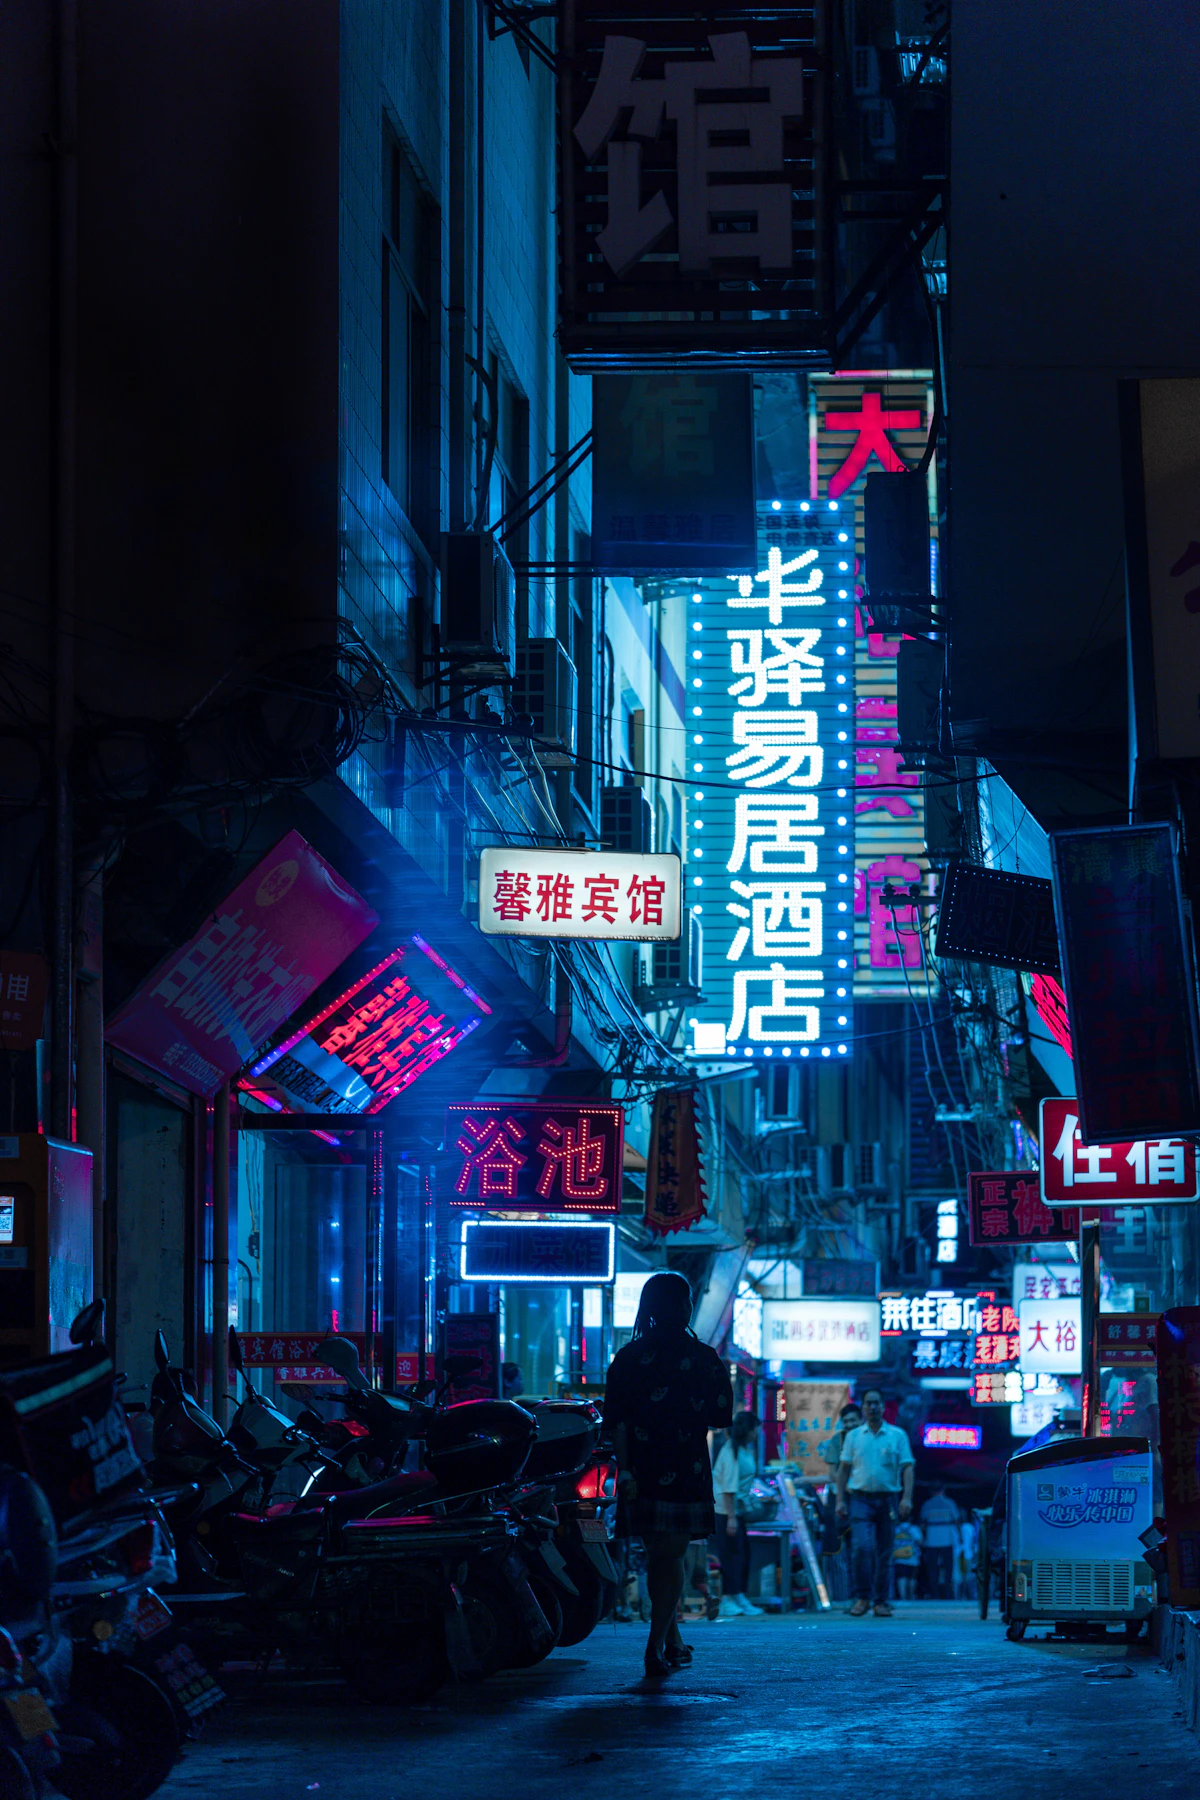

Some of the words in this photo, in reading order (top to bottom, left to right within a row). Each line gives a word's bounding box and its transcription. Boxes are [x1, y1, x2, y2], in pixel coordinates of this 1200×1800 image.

[573, 30, 803, 279] 馆
[725, 546, 827, 1042] 华驿易居酒店
[493, 869, 666, 927] 馨雅宾馆
[149, 908, 317, 1046] 自助洗衣吧
[1082, 881, 1183, 1130] 兰州拉面
[453, 1115, 609, 1200] 浴池
[1046, 1504, 1134, 1523] 快乐传中国
[1057, 1484, 1085, 1500] 蒙牛
[1086, 1487, 1137, 1505] 冰淇淋
